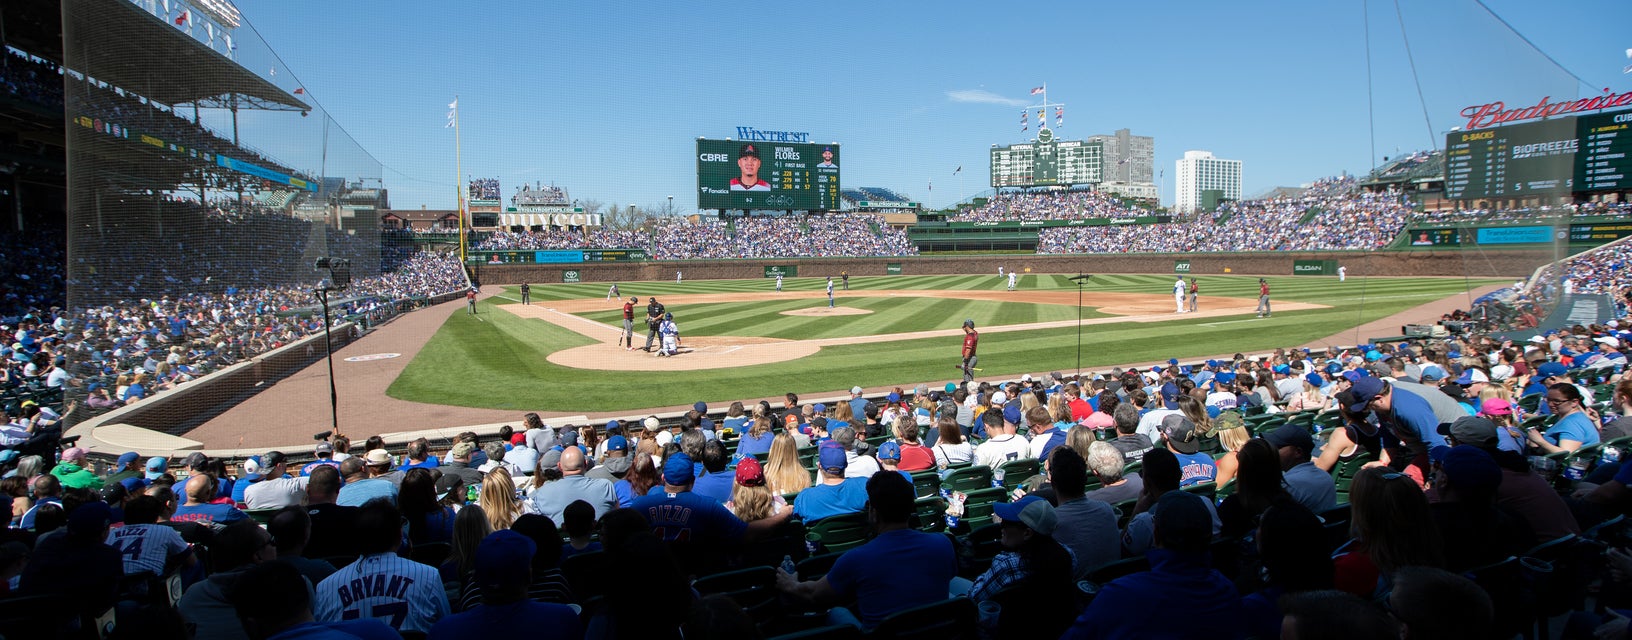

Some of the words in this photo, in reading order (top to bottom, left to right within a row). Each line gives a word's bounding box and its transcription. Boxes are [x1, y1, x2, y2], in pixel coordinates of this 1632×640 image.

[1460, 88, 1632, 130] Budweise
[1614, 113, 1632, 123] CUB
[736, 126, 809, 142] WINTRUST
[1462, 131, 1495, 142] D-BACKS
[700, 153, 728, 162] CBRE
[775, 152, 800, 160] FLORES
[1566, 179, 1573, 187] 5
[649, 505, 692, 525] RIZZO
[338, 574, 414, 608] BRYANT
